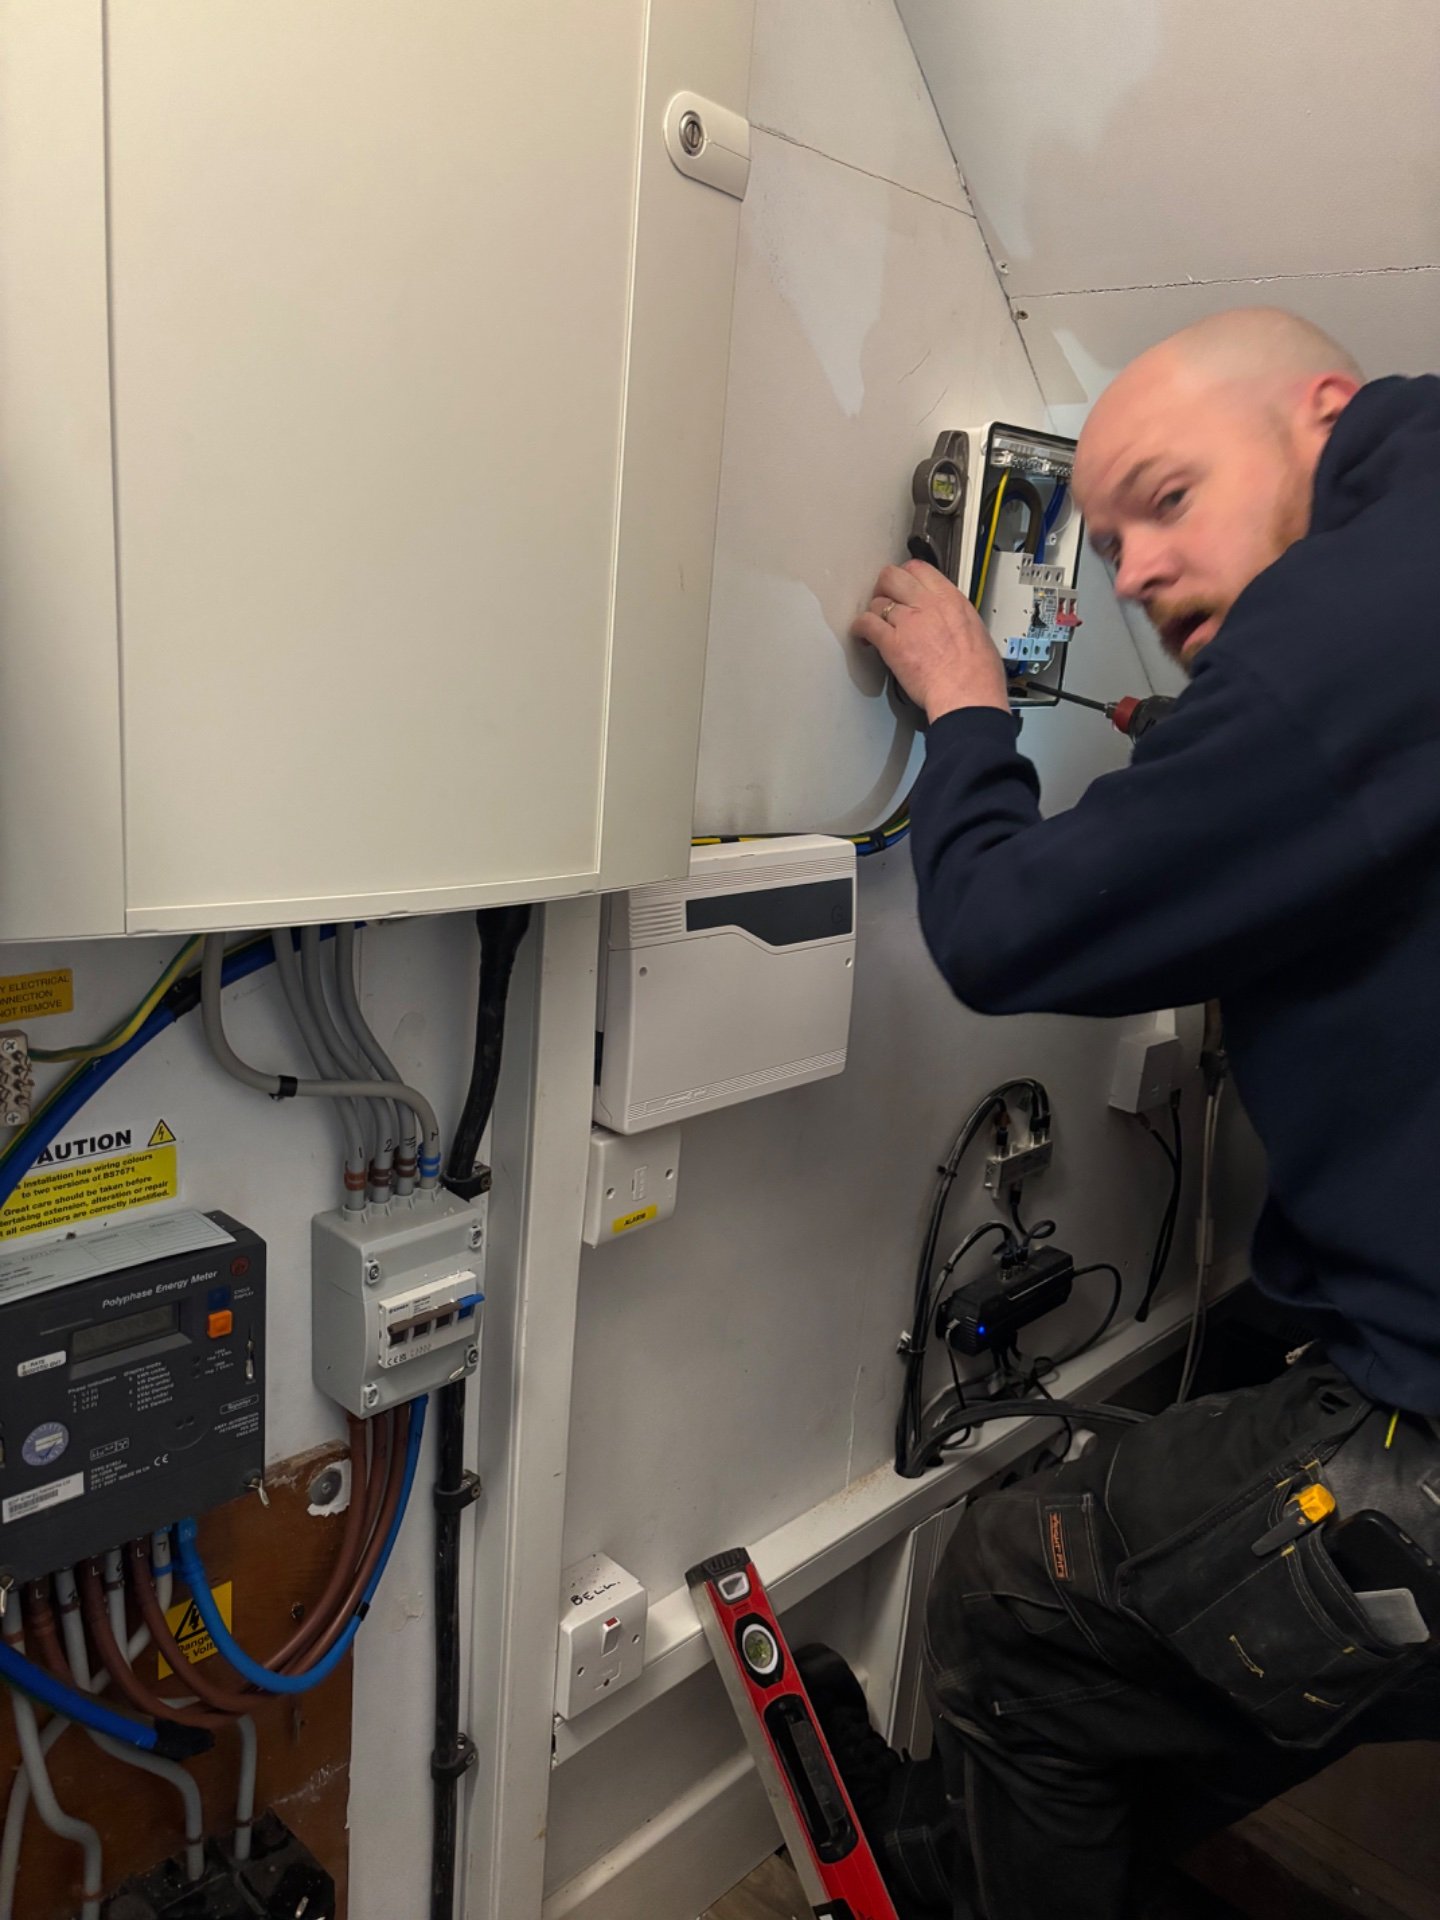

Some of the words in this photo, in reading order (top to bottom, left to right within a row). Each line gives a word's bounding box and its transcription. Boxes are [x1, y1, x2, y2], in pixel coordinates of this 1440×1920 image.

[9, 976, 69, 992] ELECTRICAL
[0, 989, 53, 1006] NNECTION
[20, 1000, 62, 1014] REMOVE
[37, 1130, 131, 1164] AUTION
[384, 1138, 392, 1152] 2
[23, 1171, 73, 1188] installation
[76, 1167, 92, 1177] has
[94, 1161, 120, 1173] wiring
[122, 1154, 153, 1166] colours
[3, 1205, 29, 1217] Great
[32, 1200, 51, 1210] care
[54, 1192, 84, 1204] should
[86, 1189, 97, 1197] be
[100, 1183, 123, 1194] taken
[125, 1176, 152, 1188] before
[22, 1191, 31, 1199] to
[34, 1187, 50, 1197] two
[53, 1178, 90, 1192] versions
[92, 1174, 101, 1183] of
[91, 1190, 132, 1205] alteration
[134, 1187, 143, 1195] or
[145, 1180, 168, 1194] repair
[6, 1226, 17, 1236] all
[19, 1214, 70, 1232] conductors
[73, 1210, 87, 1219] are
[89, 1199, 127, 1214] correctly
[129, 1190, 170, 1206] identified.
[102, 1288, 153, 1309] Polyphase
[155, 1279, 188, 1294] Energy
[190, 1270, 218, 1284] Meter
[177, 1636, 211, 1653] Dange
